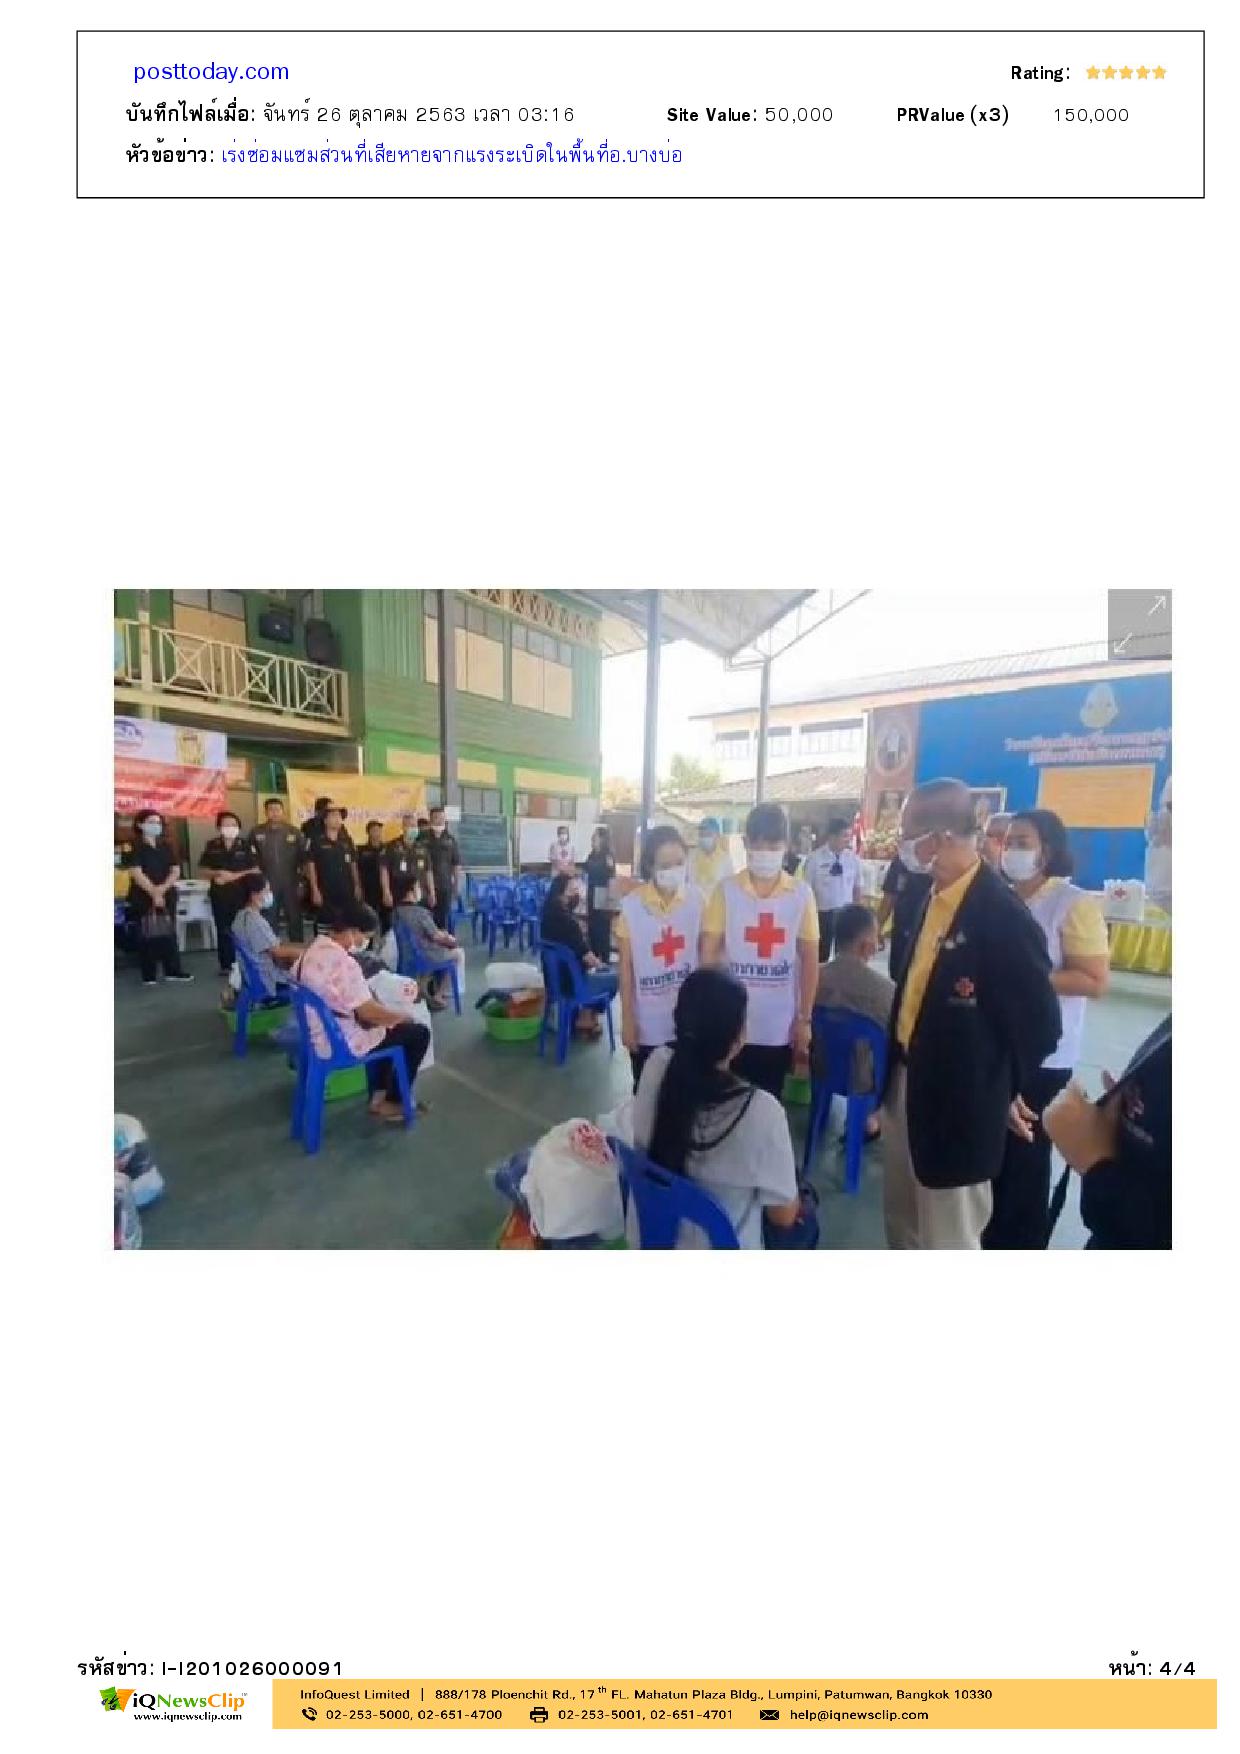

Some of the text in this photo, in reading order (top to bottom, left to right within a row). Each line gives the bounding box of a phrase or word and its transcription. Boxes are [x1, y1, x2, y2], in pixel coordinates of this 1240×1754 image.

[133, 61, 289, 84] posttoday.com
[1011, 64, 1071, 83] Rating:
[125, 97, 575, 129] บันทึกไฟล์เมื่อ: จันทร์ 26 ตุลาคม 2563 เวลา 03:16
[666, 107, 833, 125] Site Value: 50,000
[897, 104, 1129, 127] PRValue (x3) 150,000
[125, 136, 682, 163] หัวข้อข่าว: เร่งซ่อมแซมส่วนที่เสียหายจากแรงระเบิดในพื้นที่อ.บางบ่อ
[77, 1650, 154, 1676] รหัสข่าว:
[1108, 1650, 1196, 1676] หน้า: 4/4
[300, 1685, 993, 1702] InfoQuest Limited 888/178 Ploenchit Rd., 17 th FL. Mahatun Plaza Bldg., Lumpini, Patumwan, Bangkok 10330
[133, 1711, 243, 1723] www.iqnewsclip.com
[325, 1709, 503, 1721] 02-253-5000, 02-651-4700
[557, 1709, 733, 1721] 02-253-5001, 02-651-4701
[790, 1709, 930, 1722] help@iqnewsclip.com
